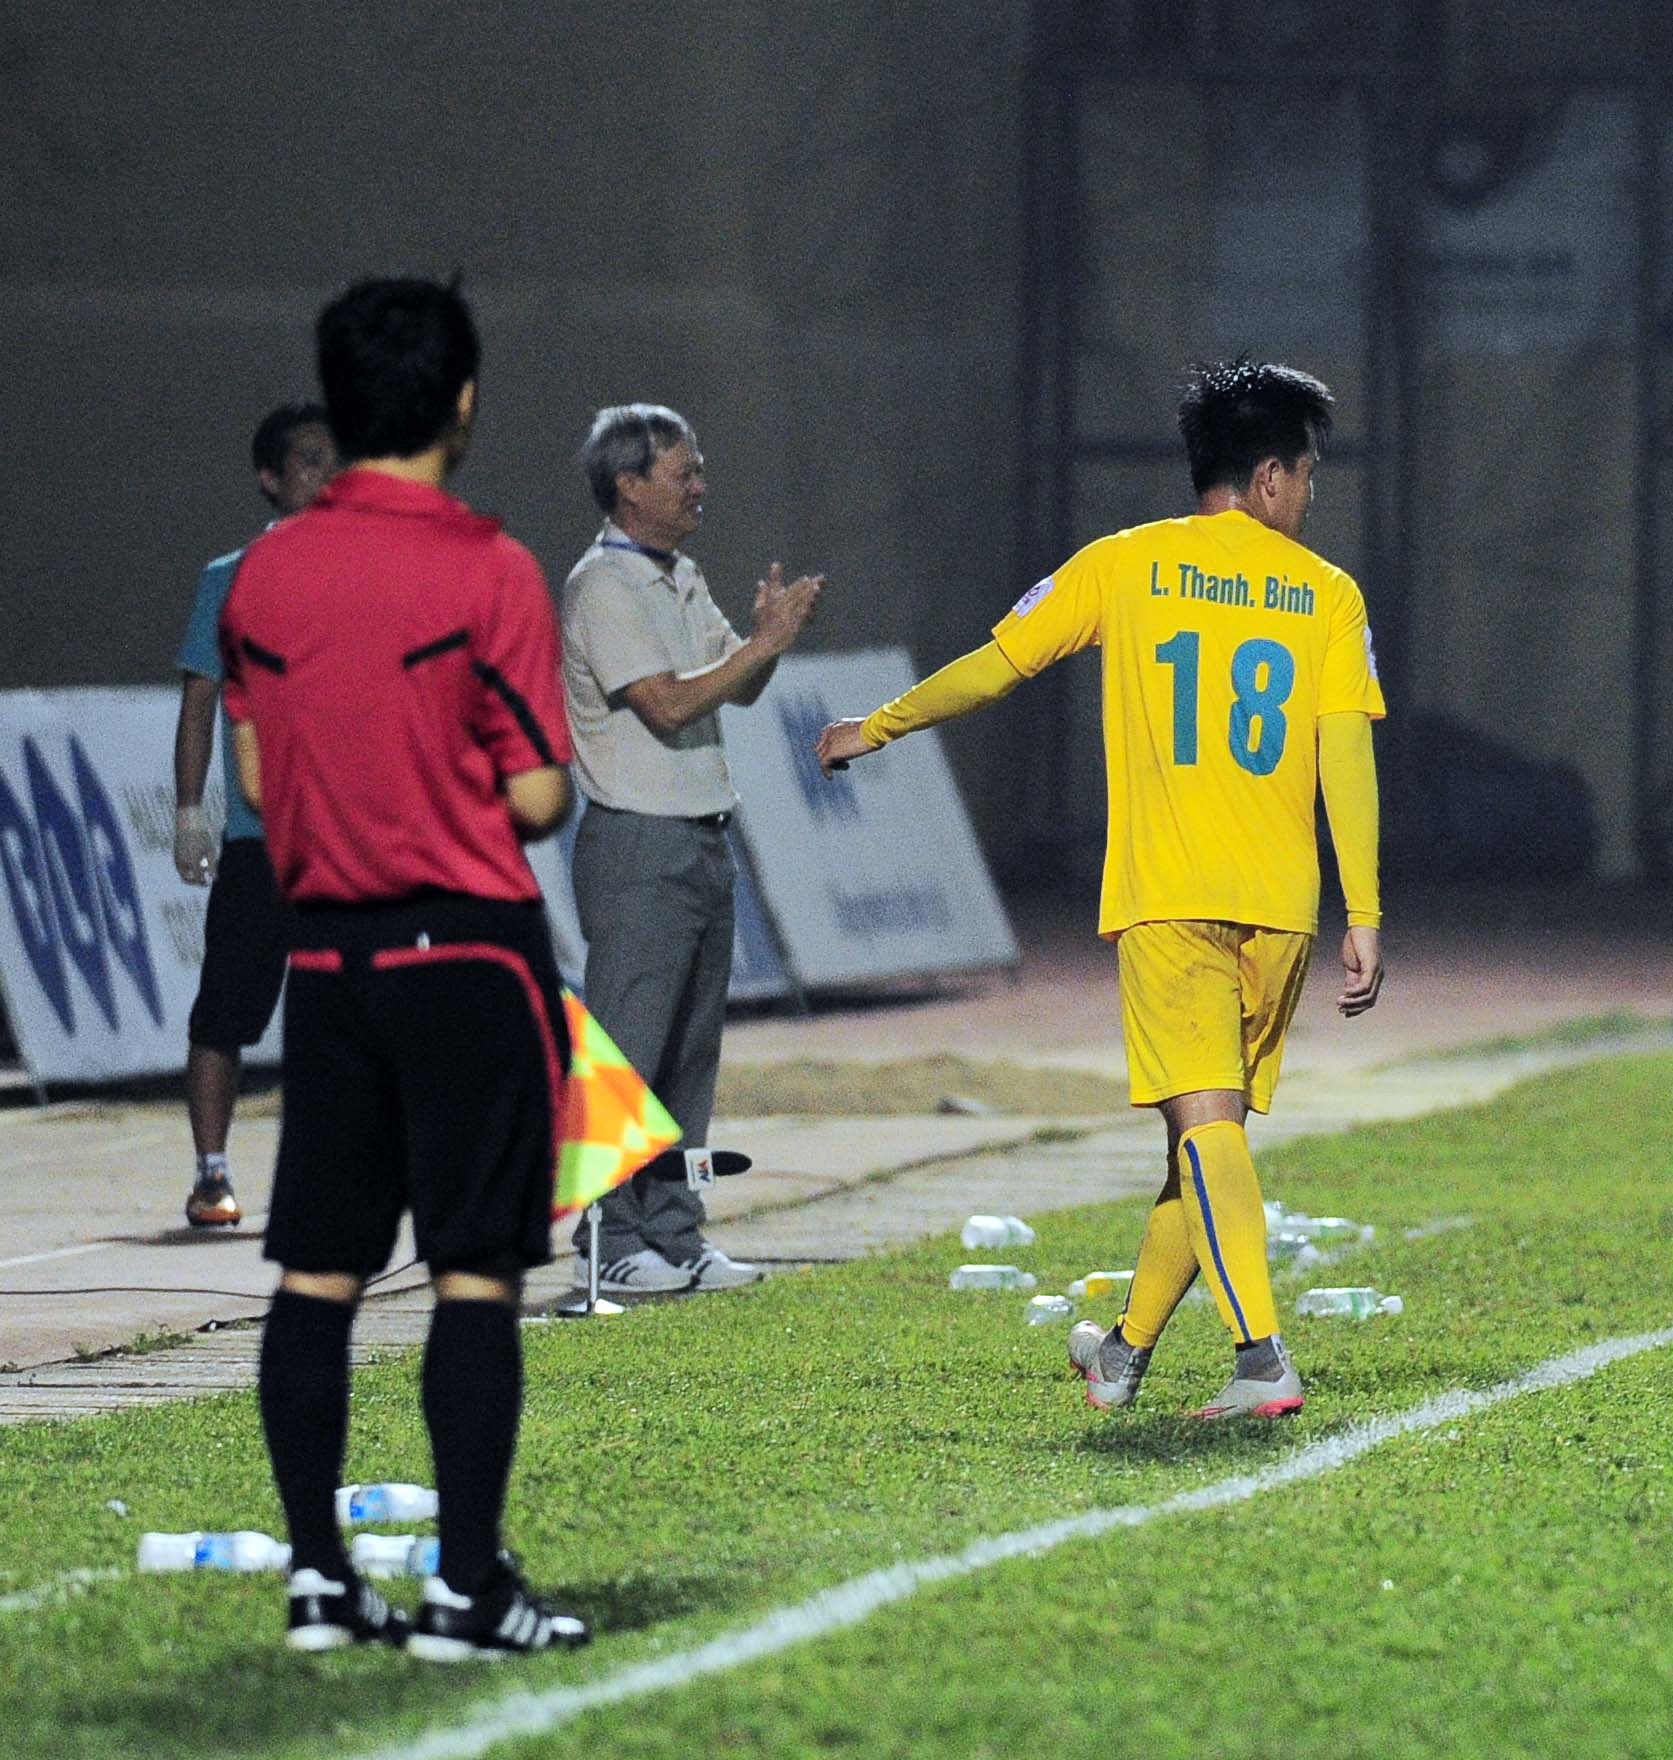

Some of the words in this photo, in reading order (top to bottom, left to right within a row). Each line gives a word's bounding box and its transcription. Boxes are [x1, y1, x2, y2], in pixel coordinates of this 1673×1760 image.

[1151, 561, 1169, 597] L.
[1178, 563, 1256, 608] Thanh.
[1155, 631, 1297, 776] 18
